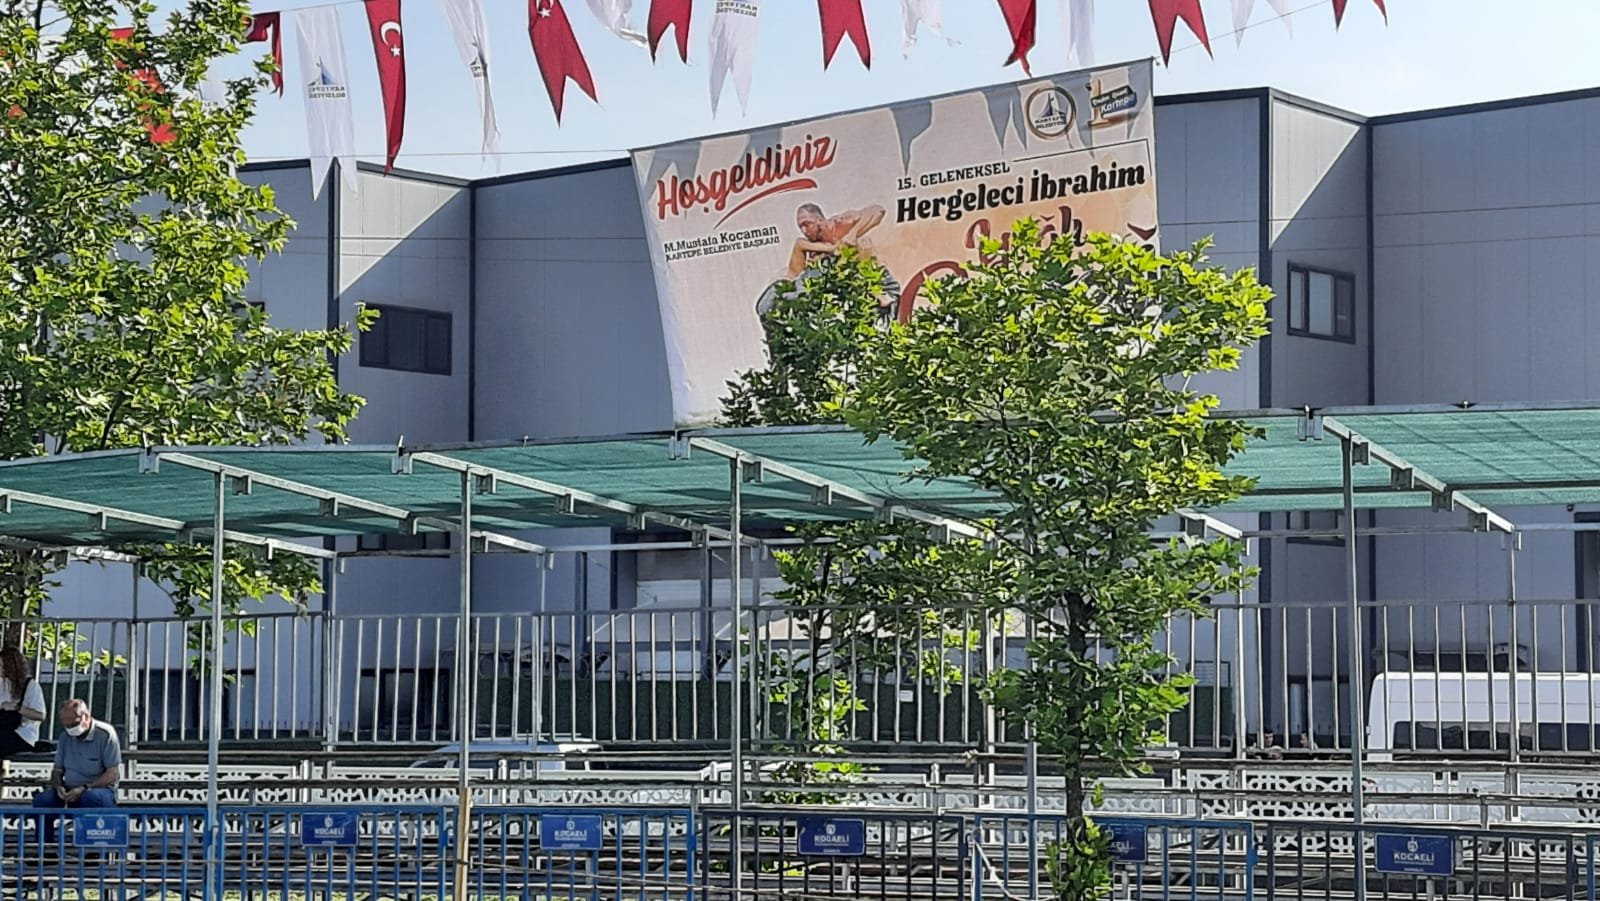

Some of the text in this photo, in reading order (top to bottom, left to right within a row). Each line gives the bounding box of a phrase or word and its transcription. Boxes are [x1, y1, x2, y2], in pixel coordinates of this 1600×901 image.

[657, 134, 838, 220] Hoşgeldiniz
[897, 161, 1011, 191] 15. GELENEKSEL
[896, 161, 1146, 223] Hergeleci İbrahim
[665, 236, 780, 262] KARTEPE BELEDİYE BAŞKANI
[720, 226, 778, 243] Kocaman
